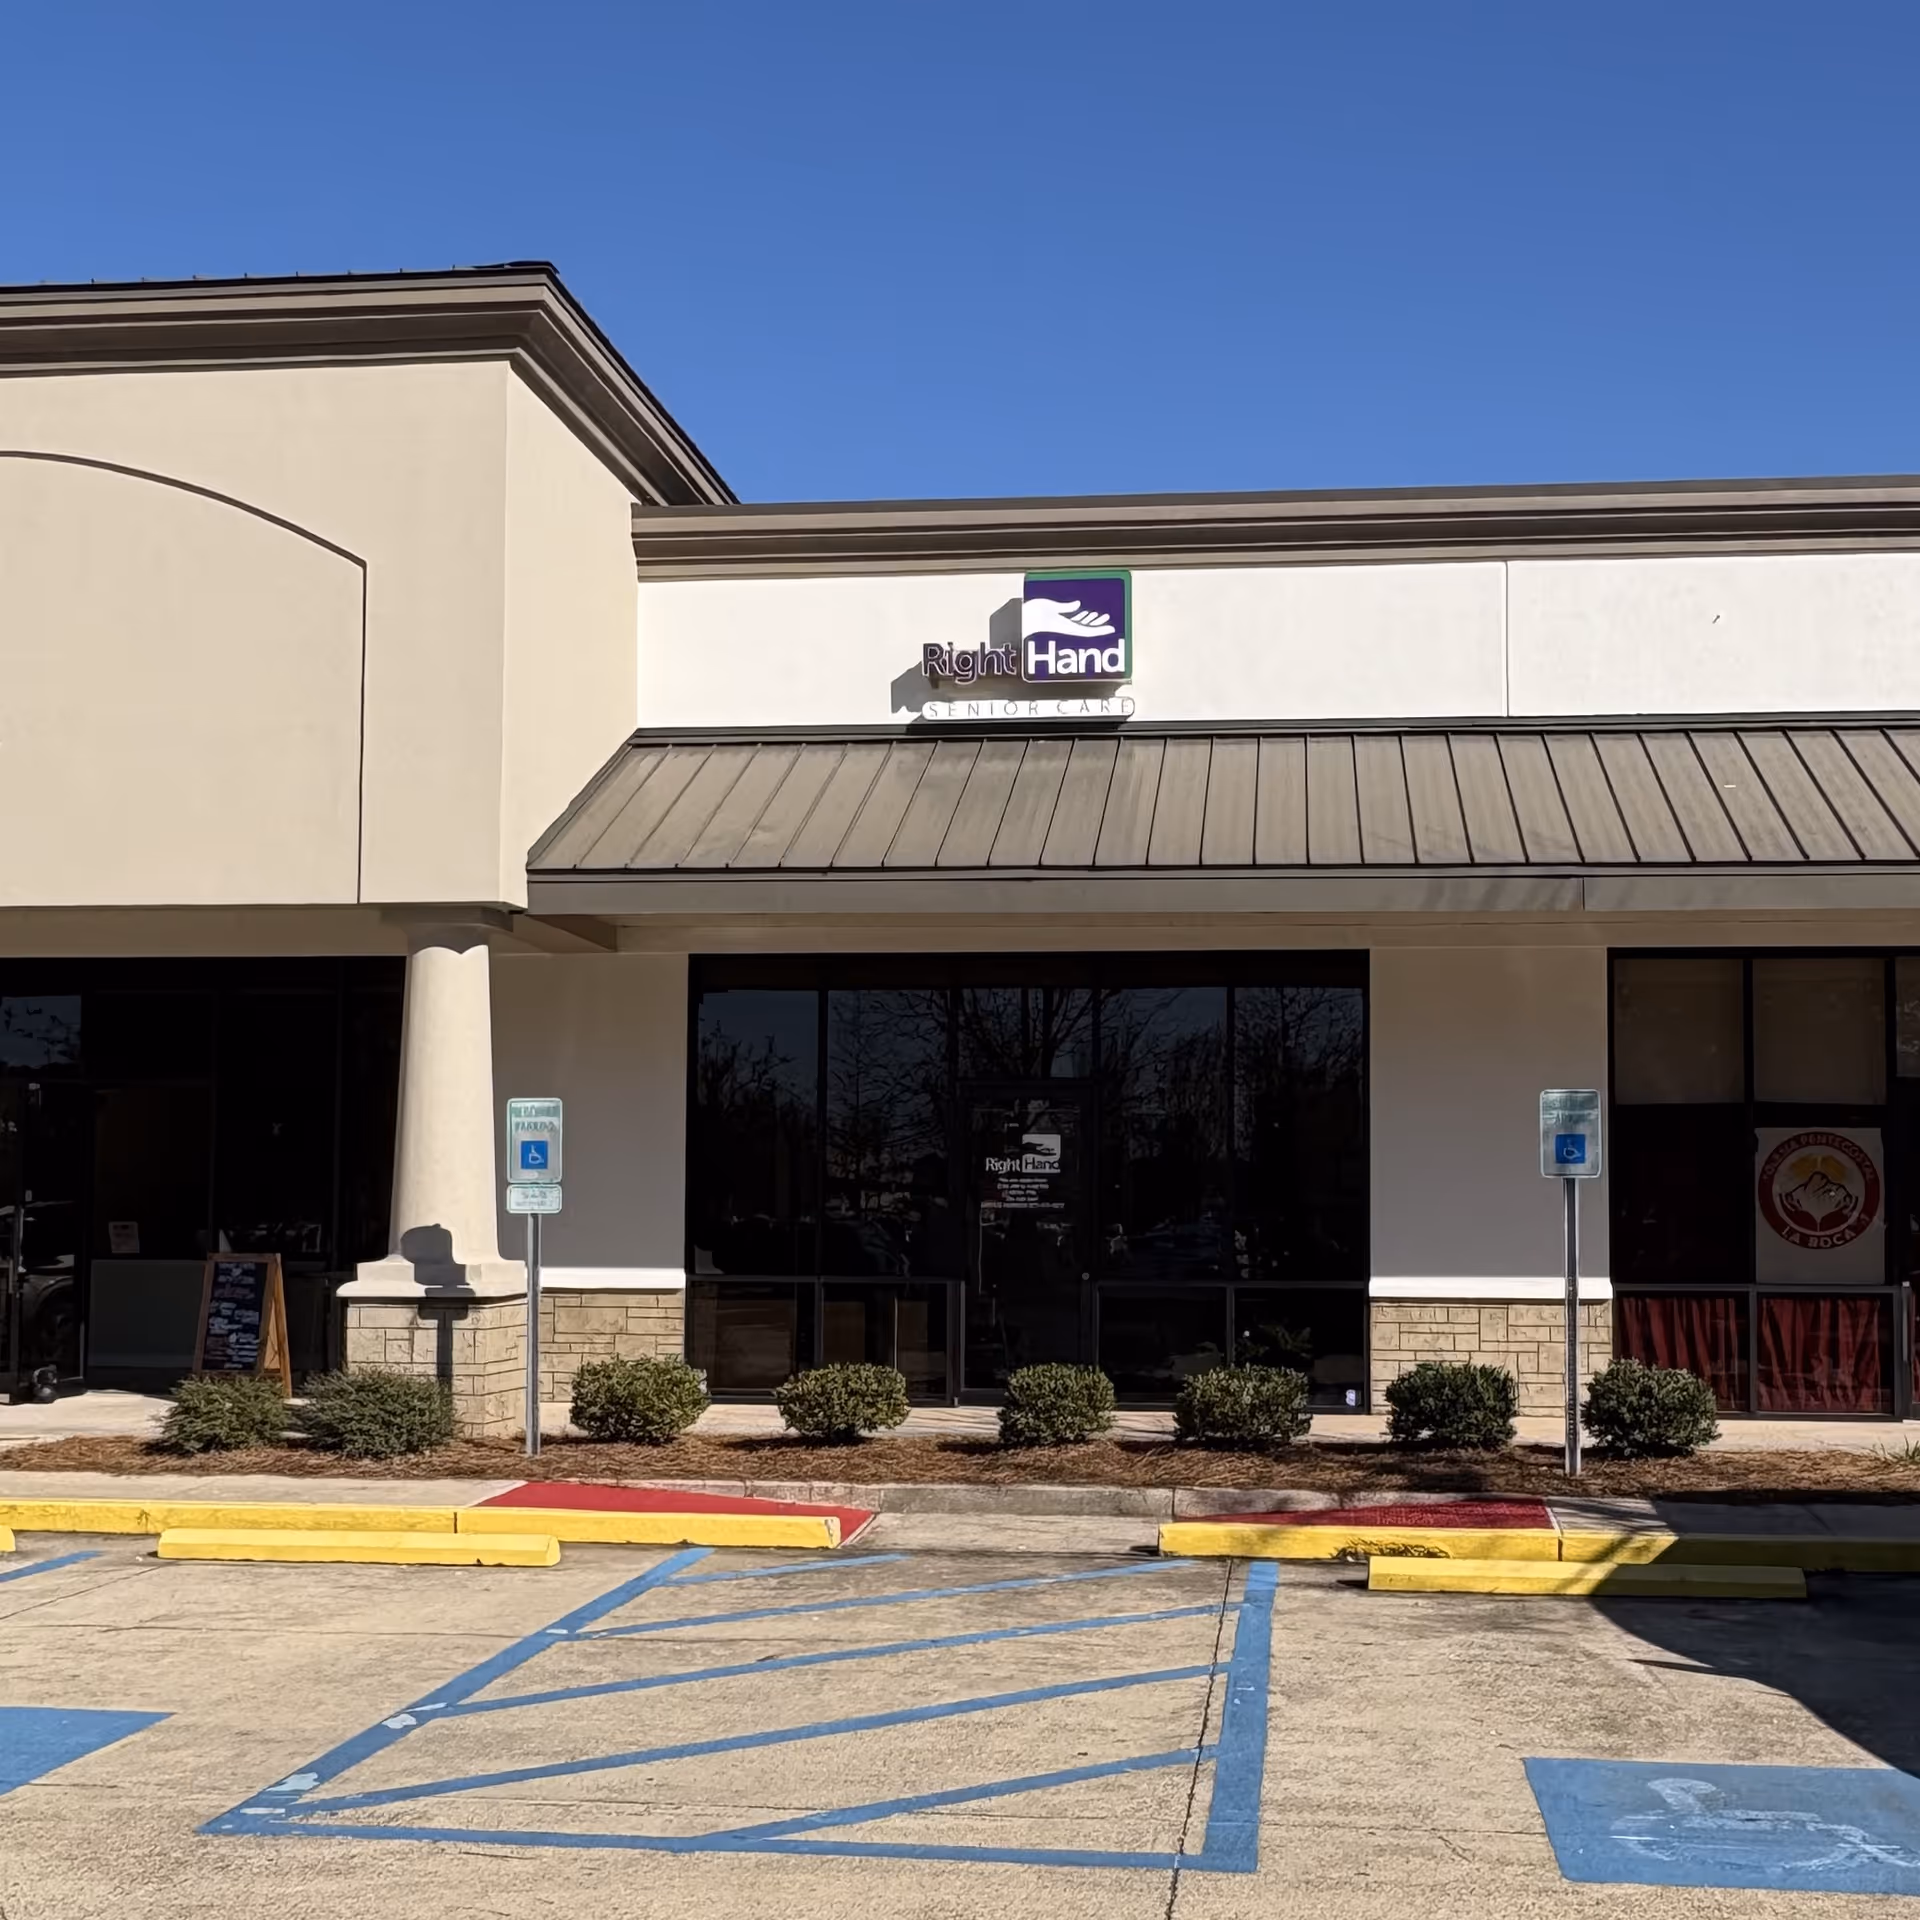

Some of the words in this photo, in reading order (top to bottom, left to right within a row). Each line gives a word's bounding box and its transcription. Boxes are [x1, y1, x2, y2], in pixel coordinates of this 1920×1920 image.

[922, 642, 1017, 686] Right
[1026, 638, 1125, 675] Hand
[928, 699, 1039, 717] SENIOR
[1056, 697, 1133, 715] CARE
[985, 1157, 1021, 1174] Right
